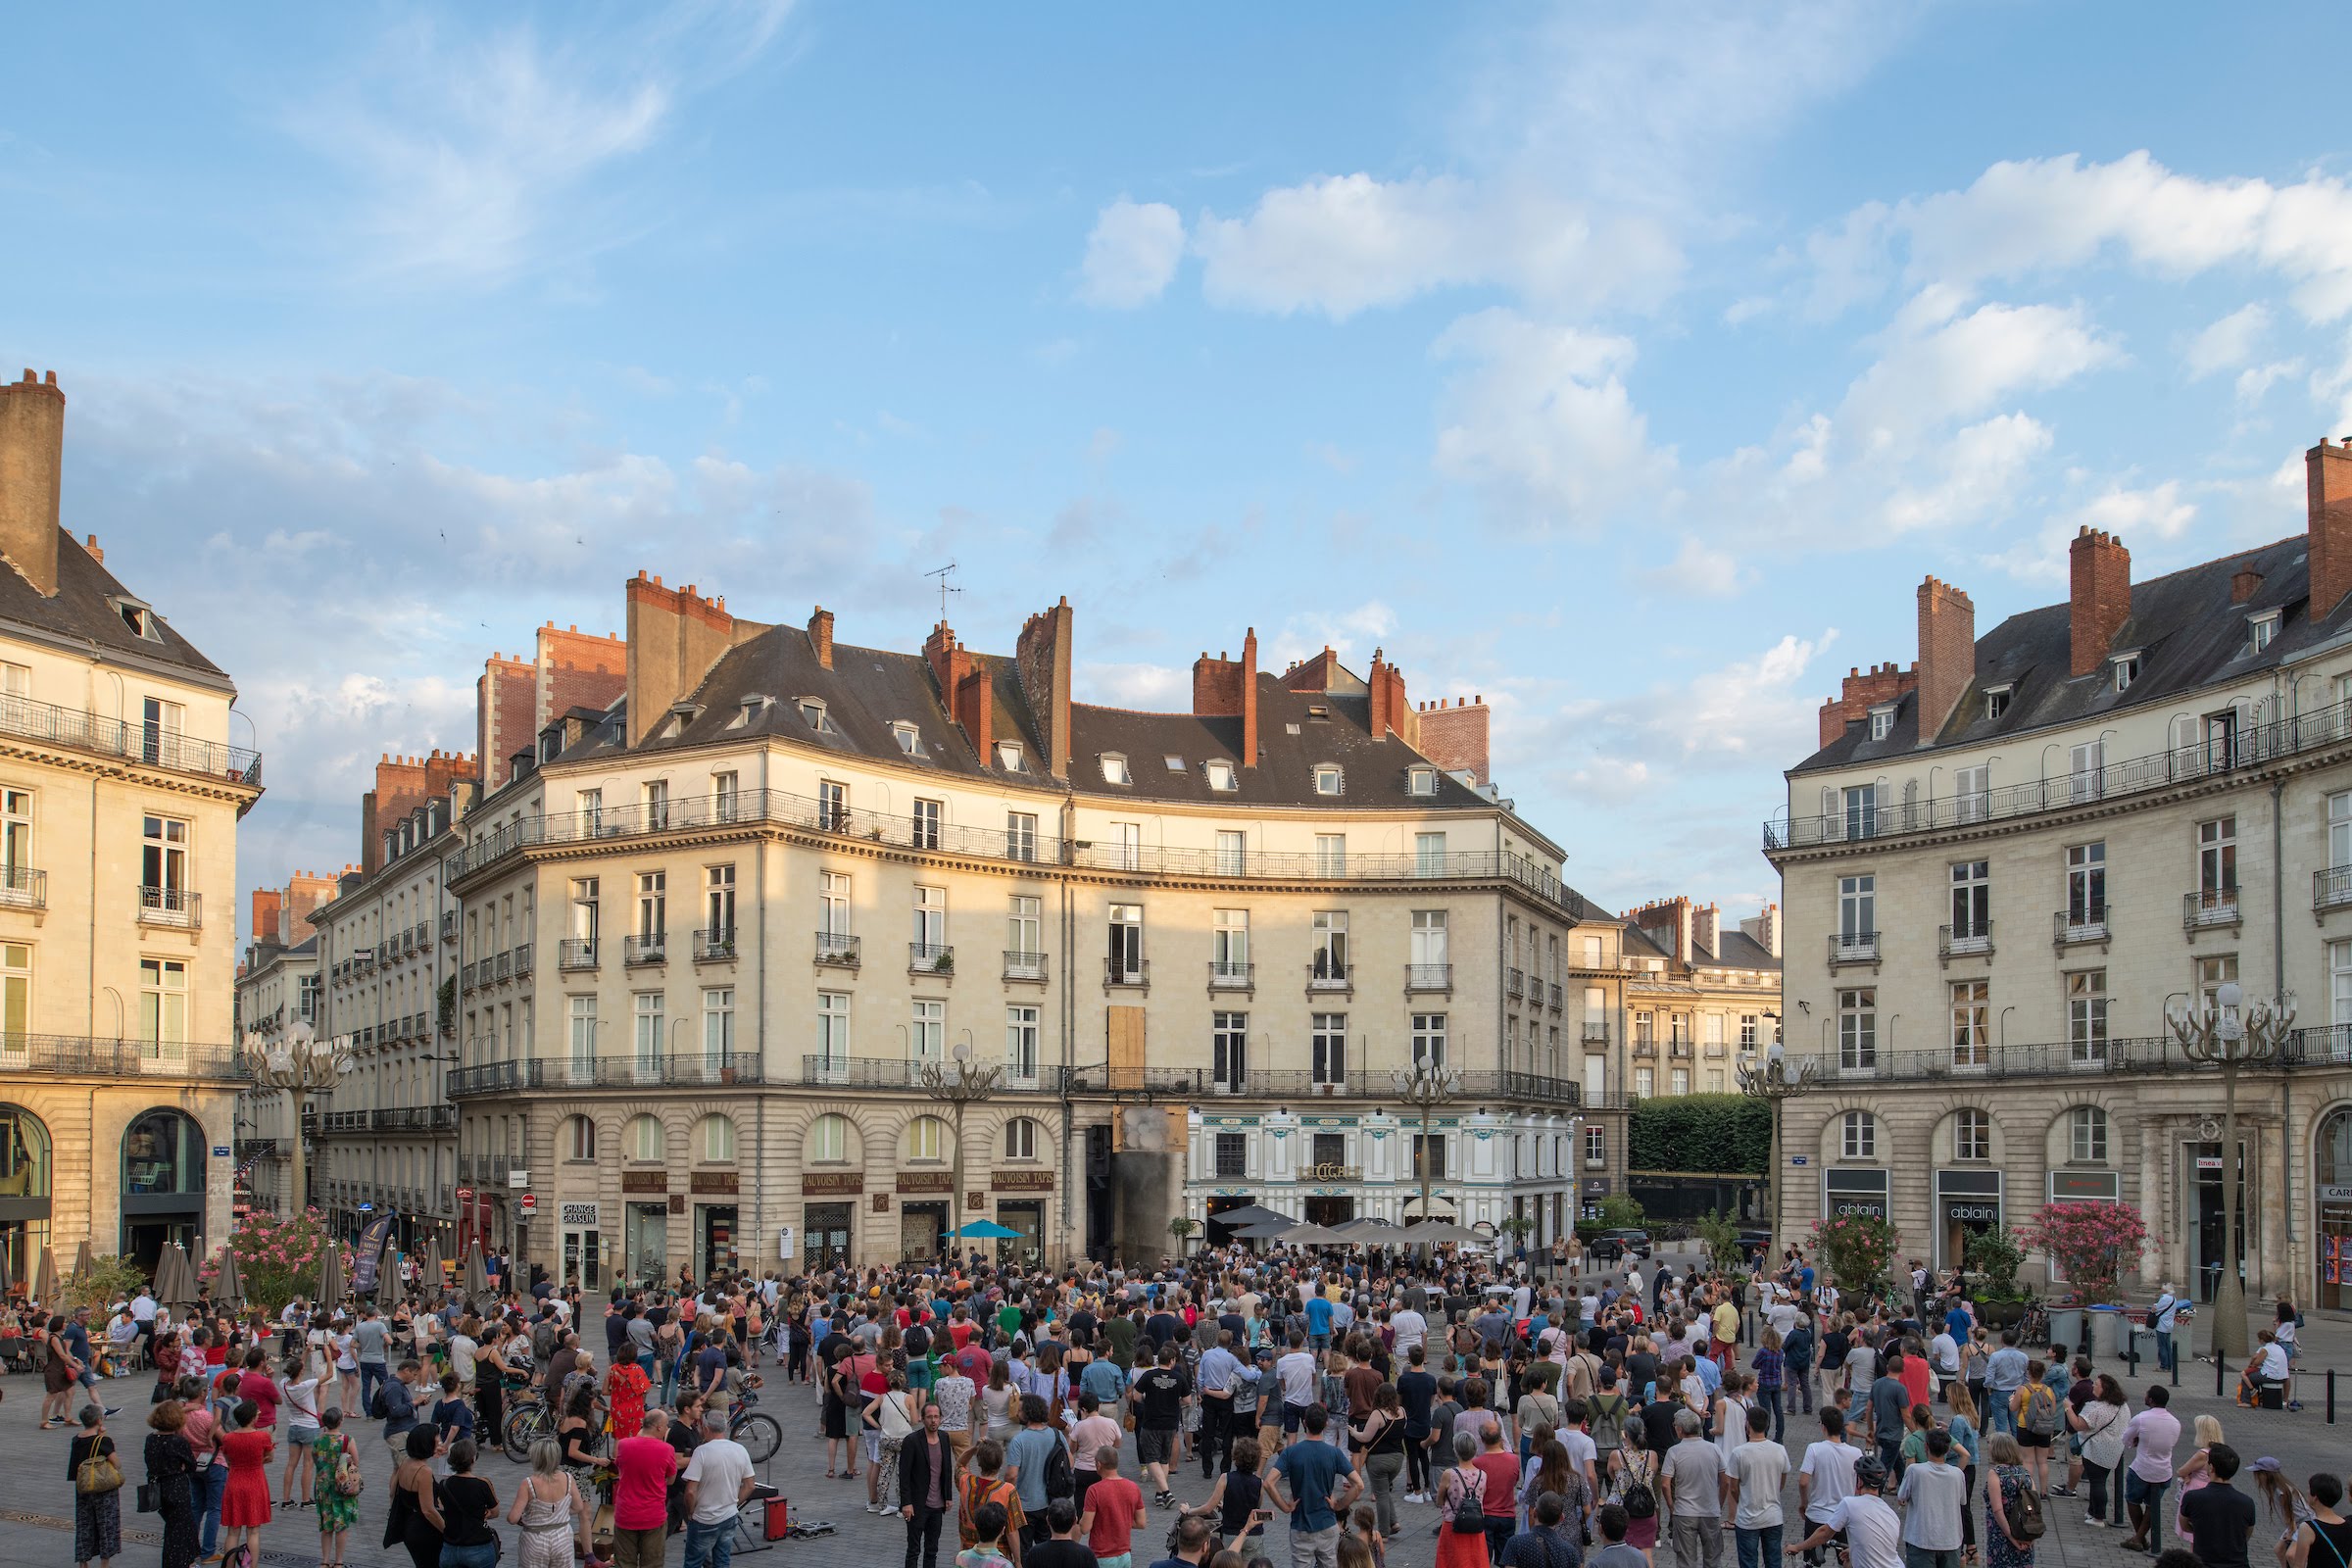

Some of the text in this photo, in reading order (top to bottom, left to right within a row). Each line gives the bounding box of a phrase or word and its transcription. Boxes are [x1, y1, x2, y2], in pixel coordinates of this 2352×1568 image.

[937, 1173, 954, 1185] TAPI
[991, 1172, 1054, 1184] MAUVOISIN TAPIS
[2328, 1188, 2352, 1197] CAR
[563, 1204, 596, 1213] CHANGE
[1950, 1205, 1994, 1219] ablain
[563, 1214, 596, 1224] GRASLIN
